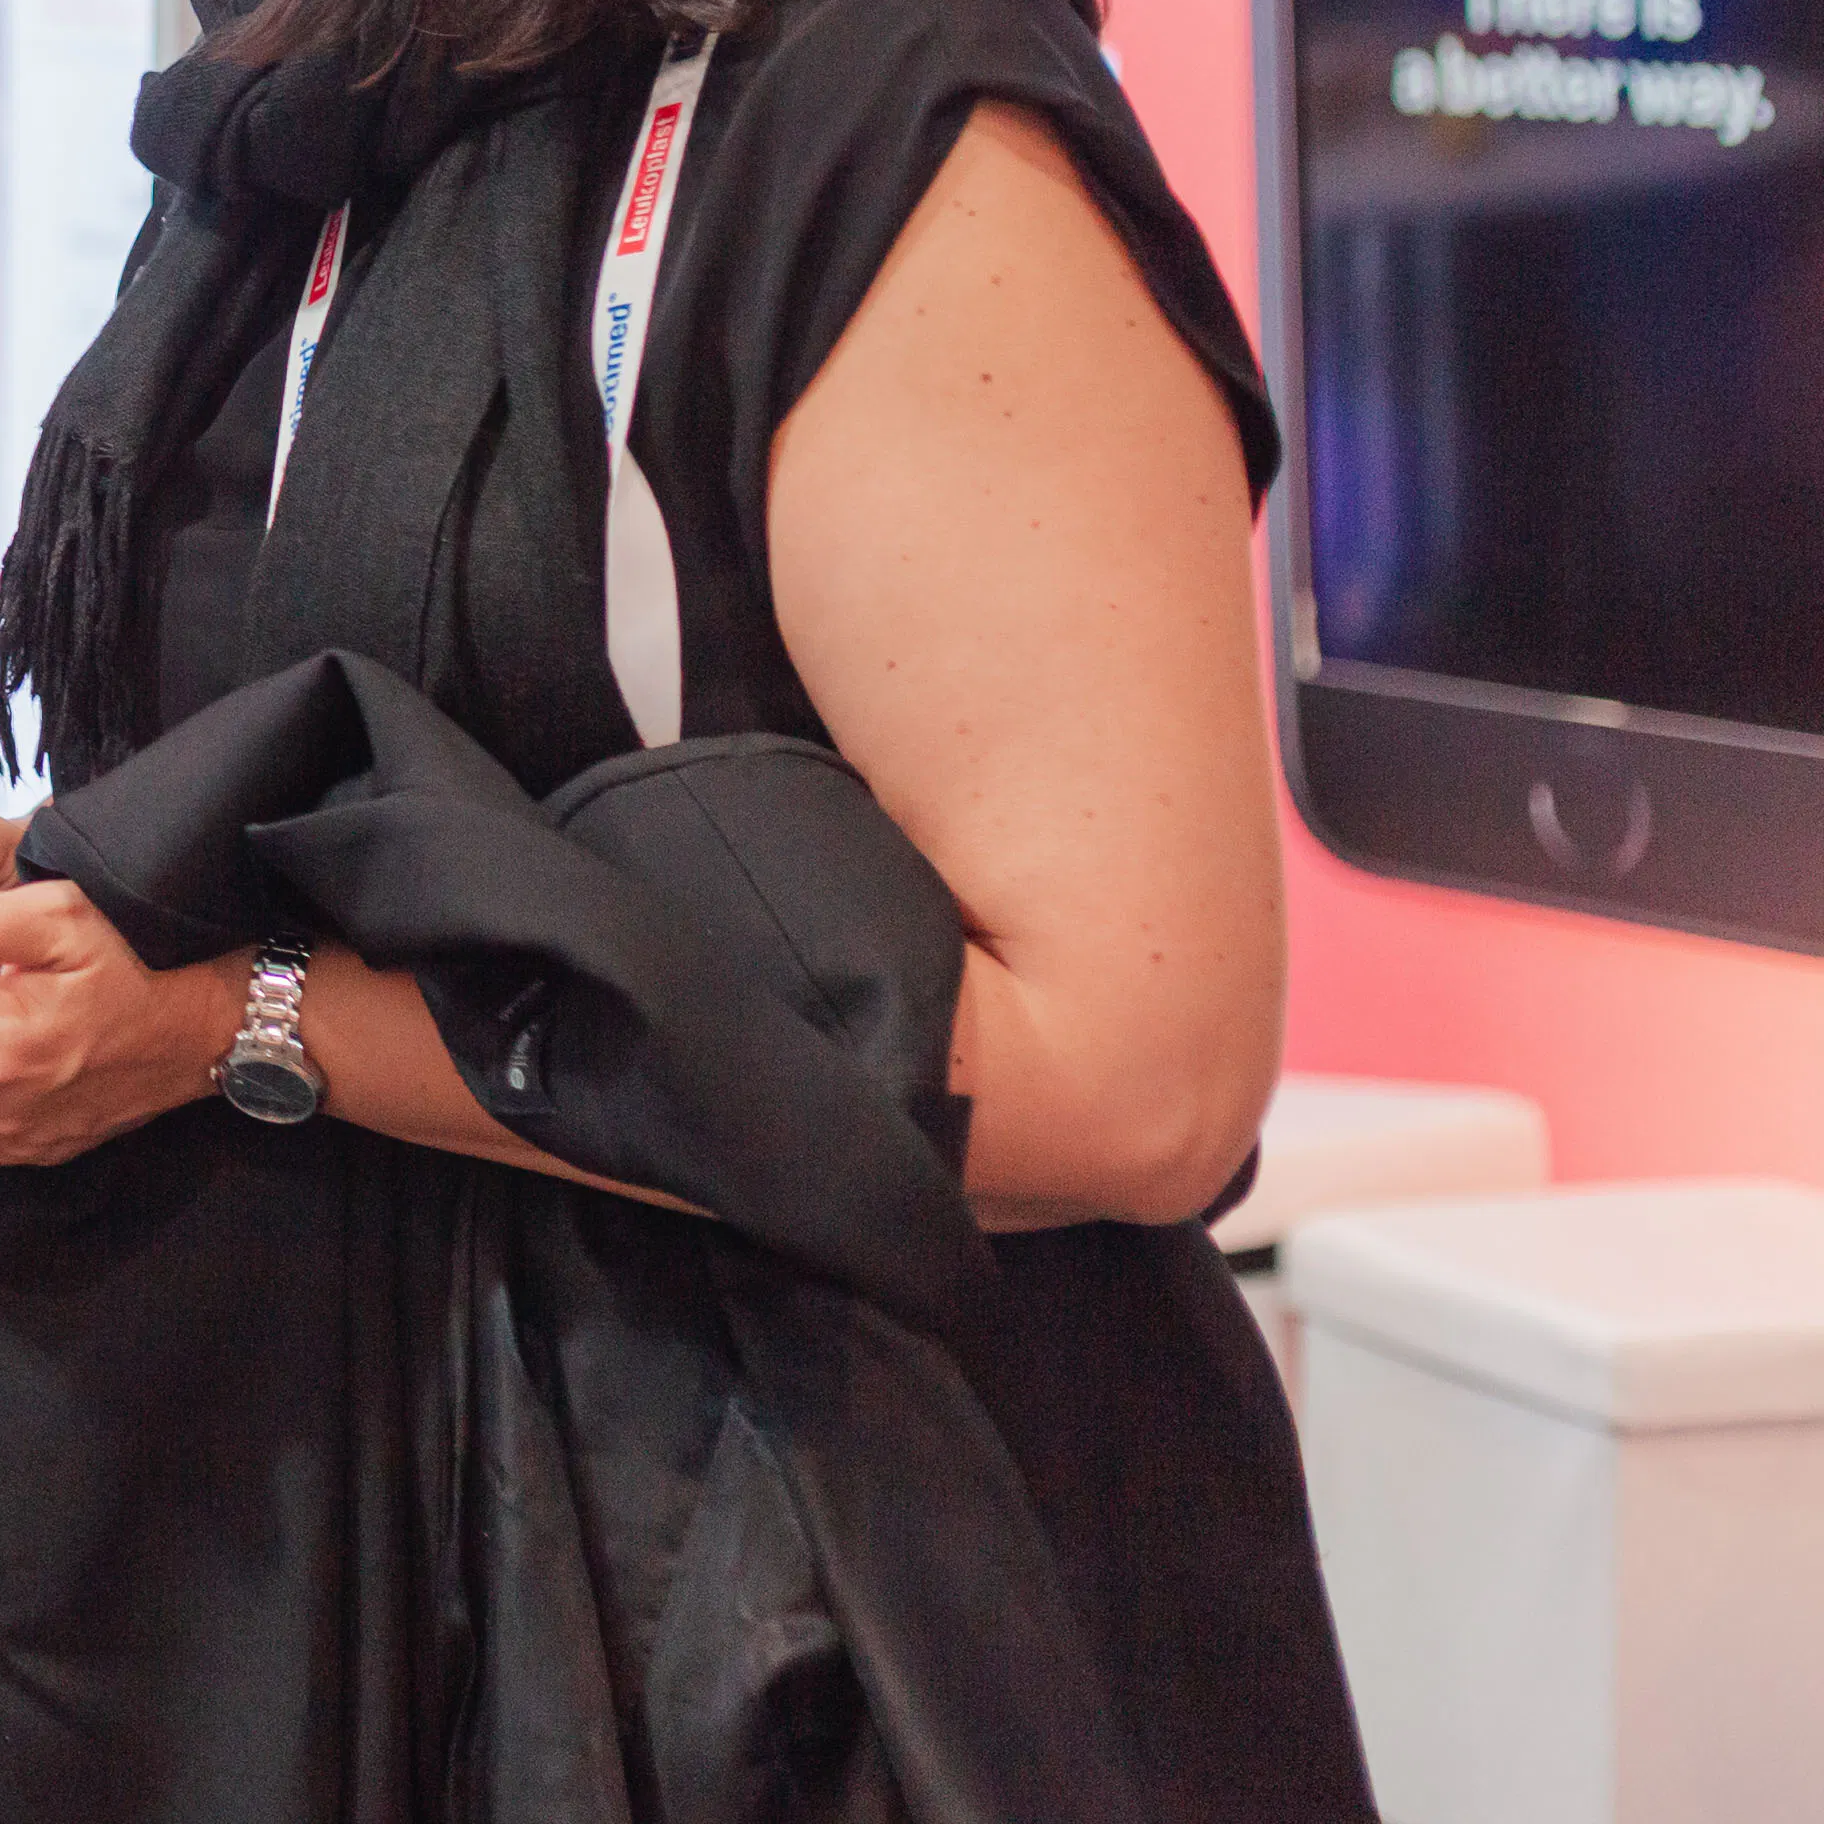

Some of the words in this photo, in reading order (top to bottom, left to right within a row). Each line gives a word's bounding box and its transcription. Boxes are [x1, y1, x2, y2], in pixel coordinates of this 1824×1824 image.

[1392, 48, 1437, 118] a
[1439, 33, 1625, 125] better
[1628, 60, 1777, 147] way.
[625, 114, 677, 243] Leukoplast
